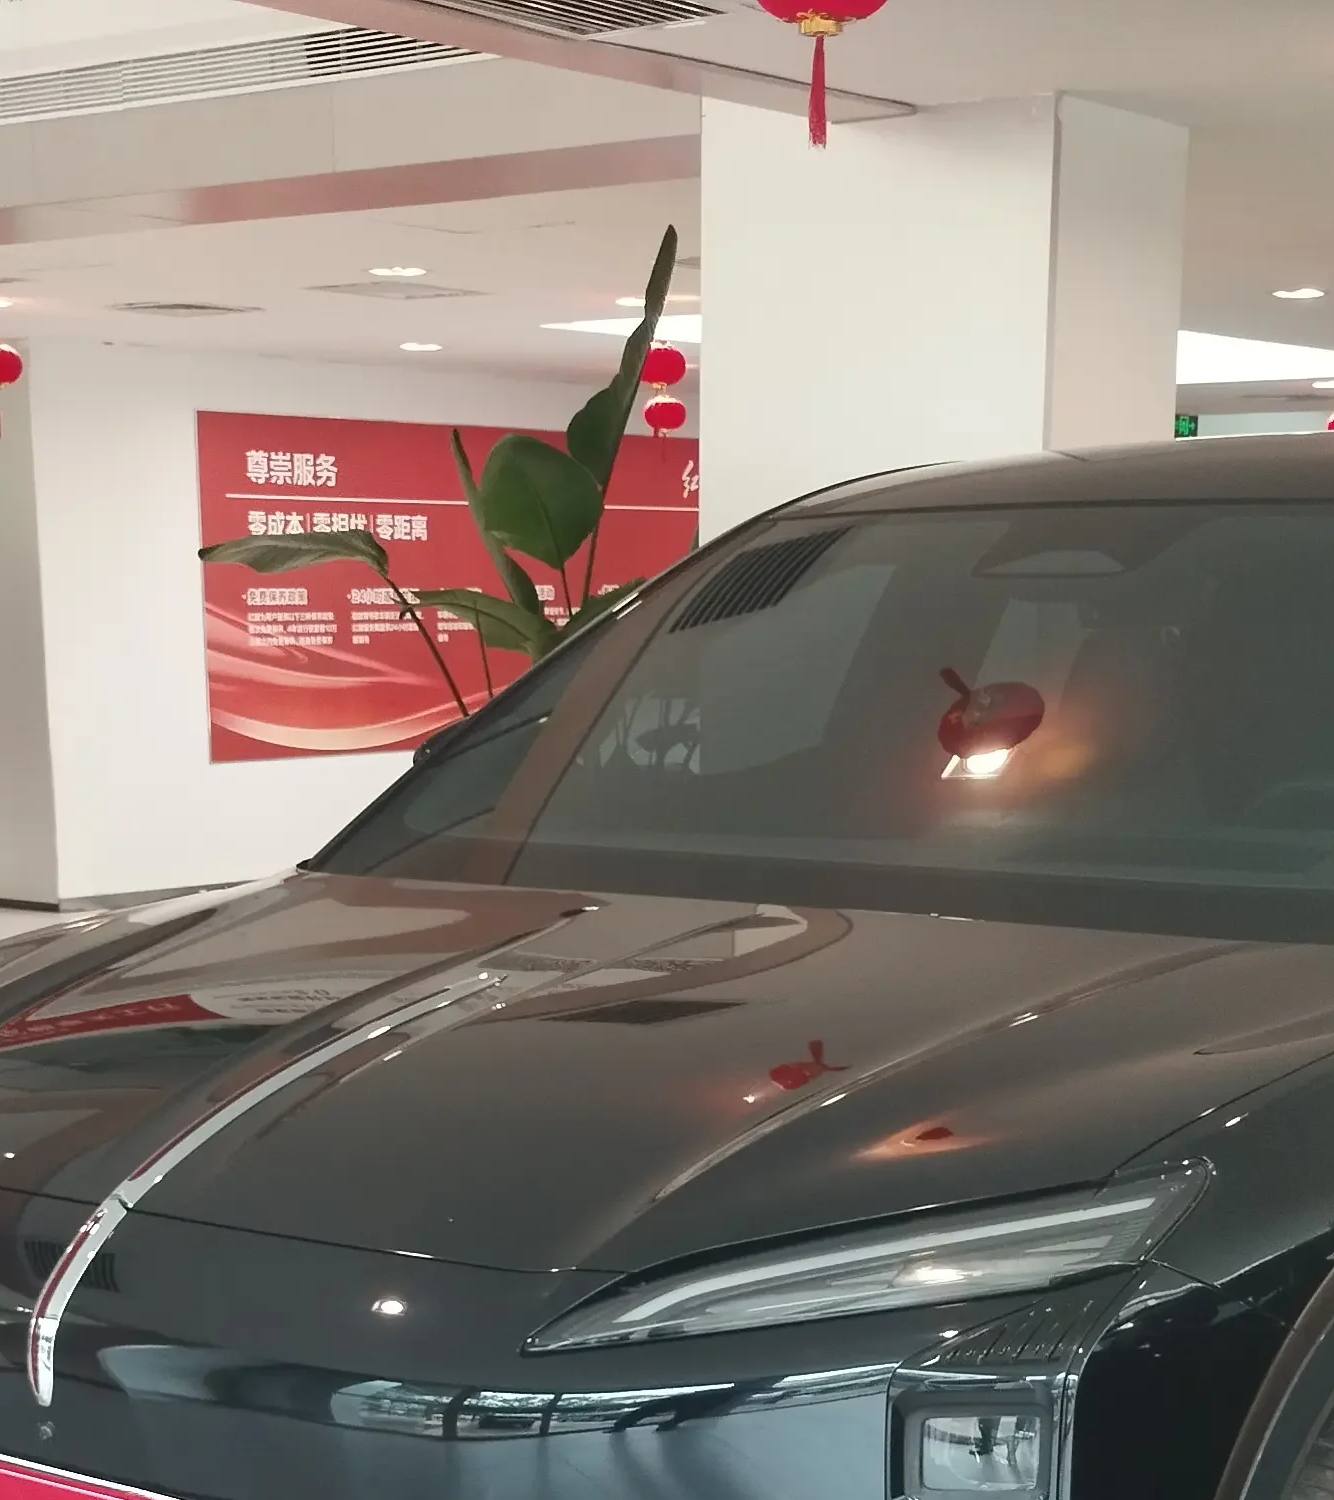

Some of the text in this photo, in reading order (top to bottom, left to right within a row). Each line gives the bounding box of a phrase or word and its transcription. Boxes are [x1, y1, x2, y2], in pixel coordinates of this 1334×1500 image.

[245, 450, 338, 487] 尊崇服务
[247, 510, 305, 535] 零成本
[376, 514, 428, 541] 零距离
